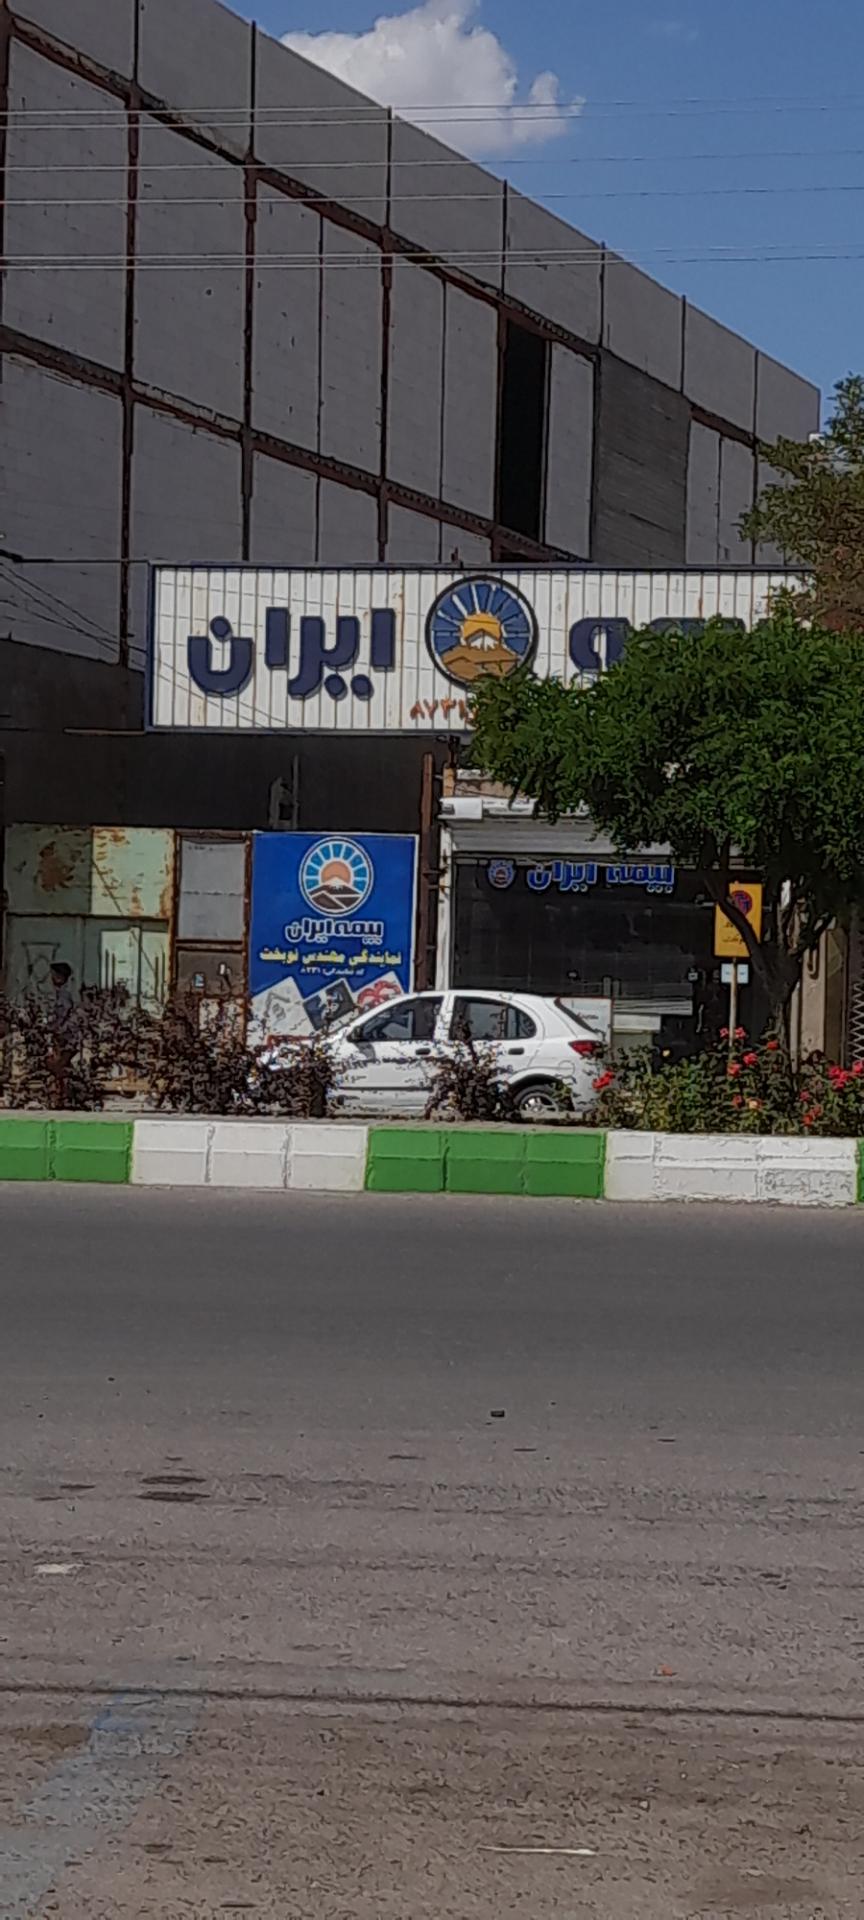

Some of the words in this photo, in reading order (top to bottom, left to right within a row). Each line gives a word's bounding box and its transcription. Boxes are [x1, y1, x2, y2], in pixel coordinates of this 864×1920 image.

[187, 607, 396, 700] ایران
[526, 859, 598, 892] ایران
[606, 863, 676, 894] بیمه
[285, 917, 334, 943] ایران
[334, 920, 384, 945] بیمه
[302, 950, 346, 965] مهندس
[349, 949, 402, 968] نمایندگی
